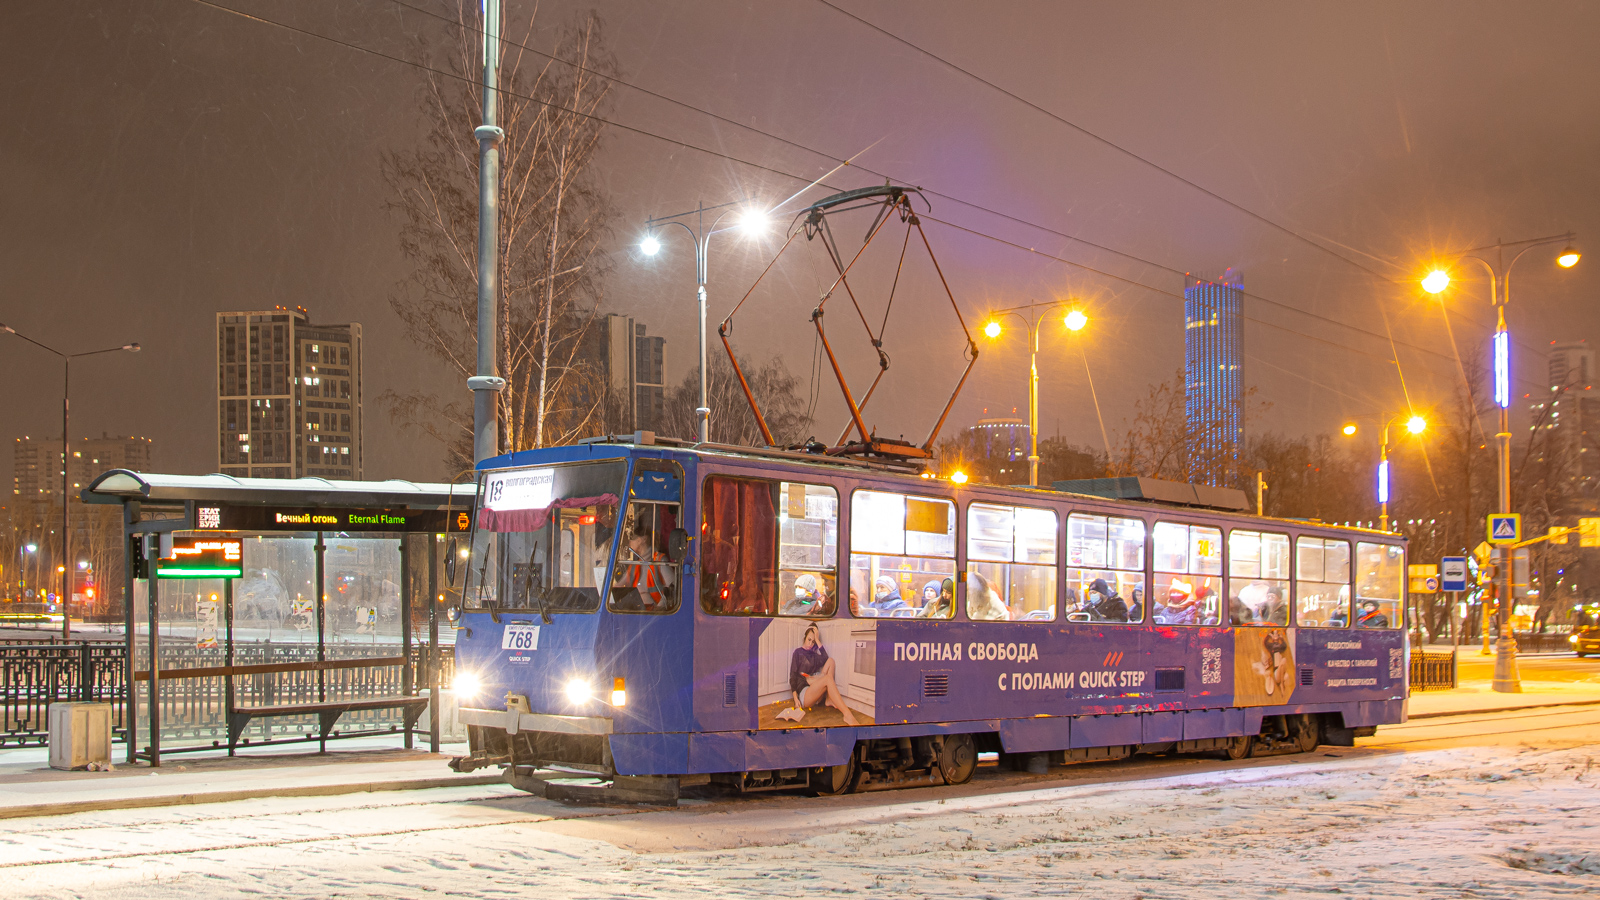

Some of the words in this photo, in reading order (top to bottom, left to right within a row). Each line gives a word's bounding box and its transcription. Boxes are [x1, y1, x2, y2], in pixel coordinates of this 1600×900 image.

[490, 480, 504, 502] 18
[276, 513, 310, 524] Вечный
[312, 515, 338, 524] огонь
[349, 514, 379, 524] Eternal
[381, 515, 405, 524] Flame
[508, 631, 532, 648] 768
[894, 642, 962, 661] ПОЛНАЯ
[968, 642, 1039, 663] СВОБОДА
[998, 672, 1007, 691] С
[1012, 672, 1074, 690] ПОЛАМИ
